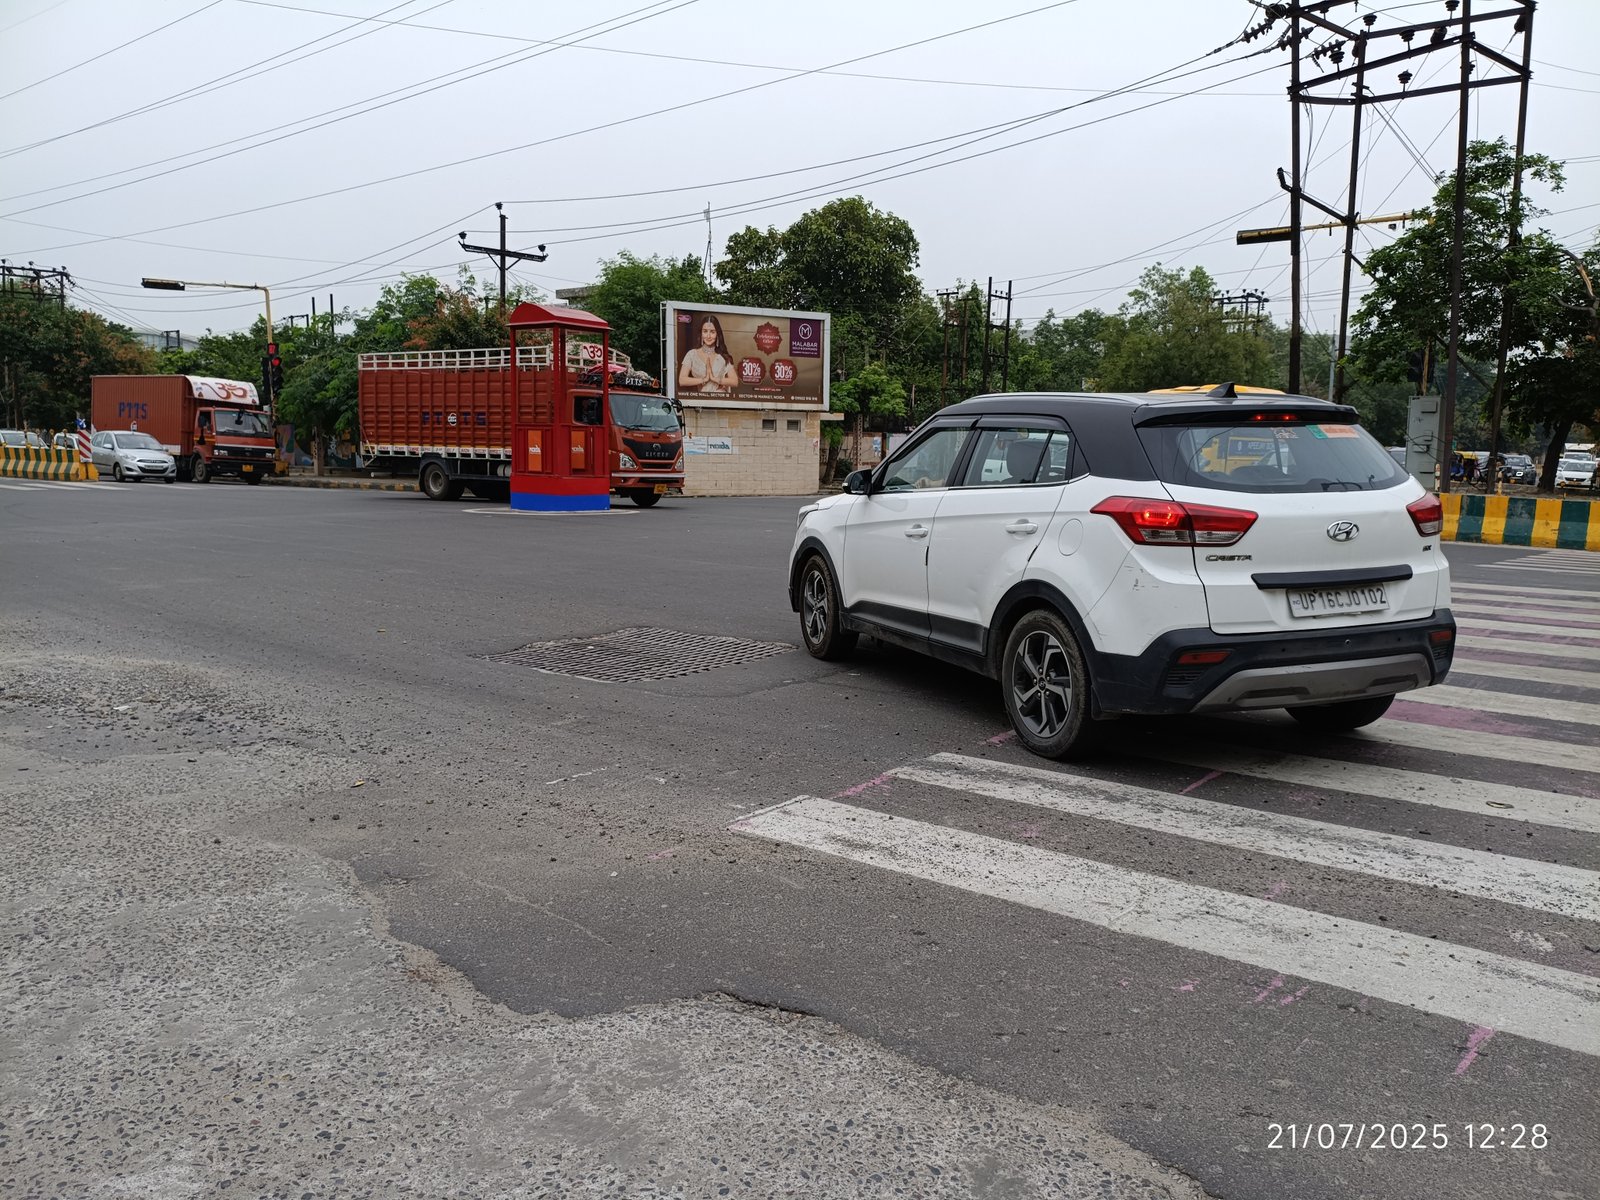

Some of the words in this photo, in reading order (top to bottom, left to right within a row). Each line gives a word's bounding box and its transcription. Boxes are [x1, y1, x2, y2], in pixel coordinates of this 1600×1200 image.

[742, 362, 760, 376] 30%
[774, 366, 792, 378] 30%
[118, 402, 148, 420] PTTS
[1300, 588, 1386, 611] UP16CJ0102
